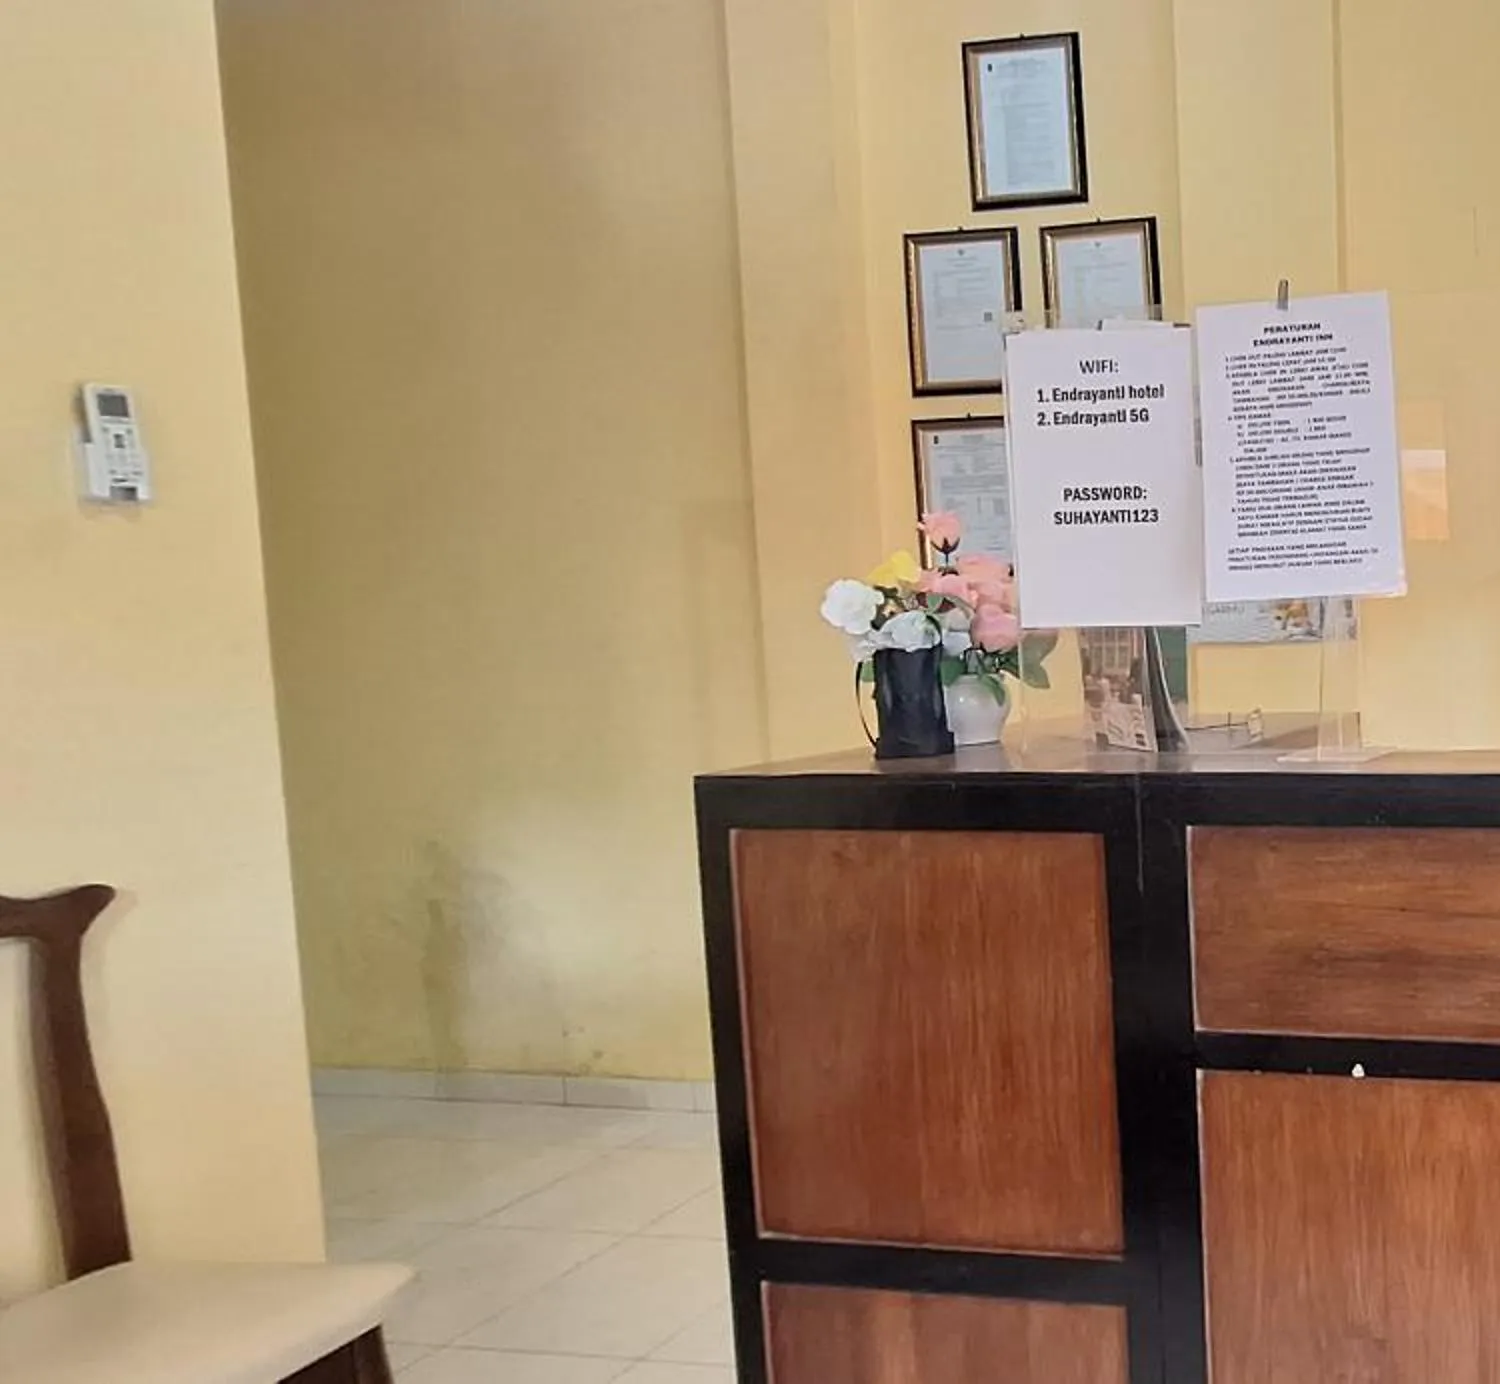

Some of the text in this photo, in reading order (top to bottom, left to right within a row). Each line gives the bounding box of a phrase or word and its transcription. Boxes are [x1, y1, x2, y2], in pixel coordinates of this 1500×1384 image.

[1079, 359, 1119, 374] WIFI:
[1037, 384, 1165, 404] 1. Endrayanti hotel
[1037, 408, 1150, 427] 2. Endrayanti 5G
[1063, 486, 1148, 502] PASSWORD:
[1054, 509, 1159, 525] SUHAYANTI123
